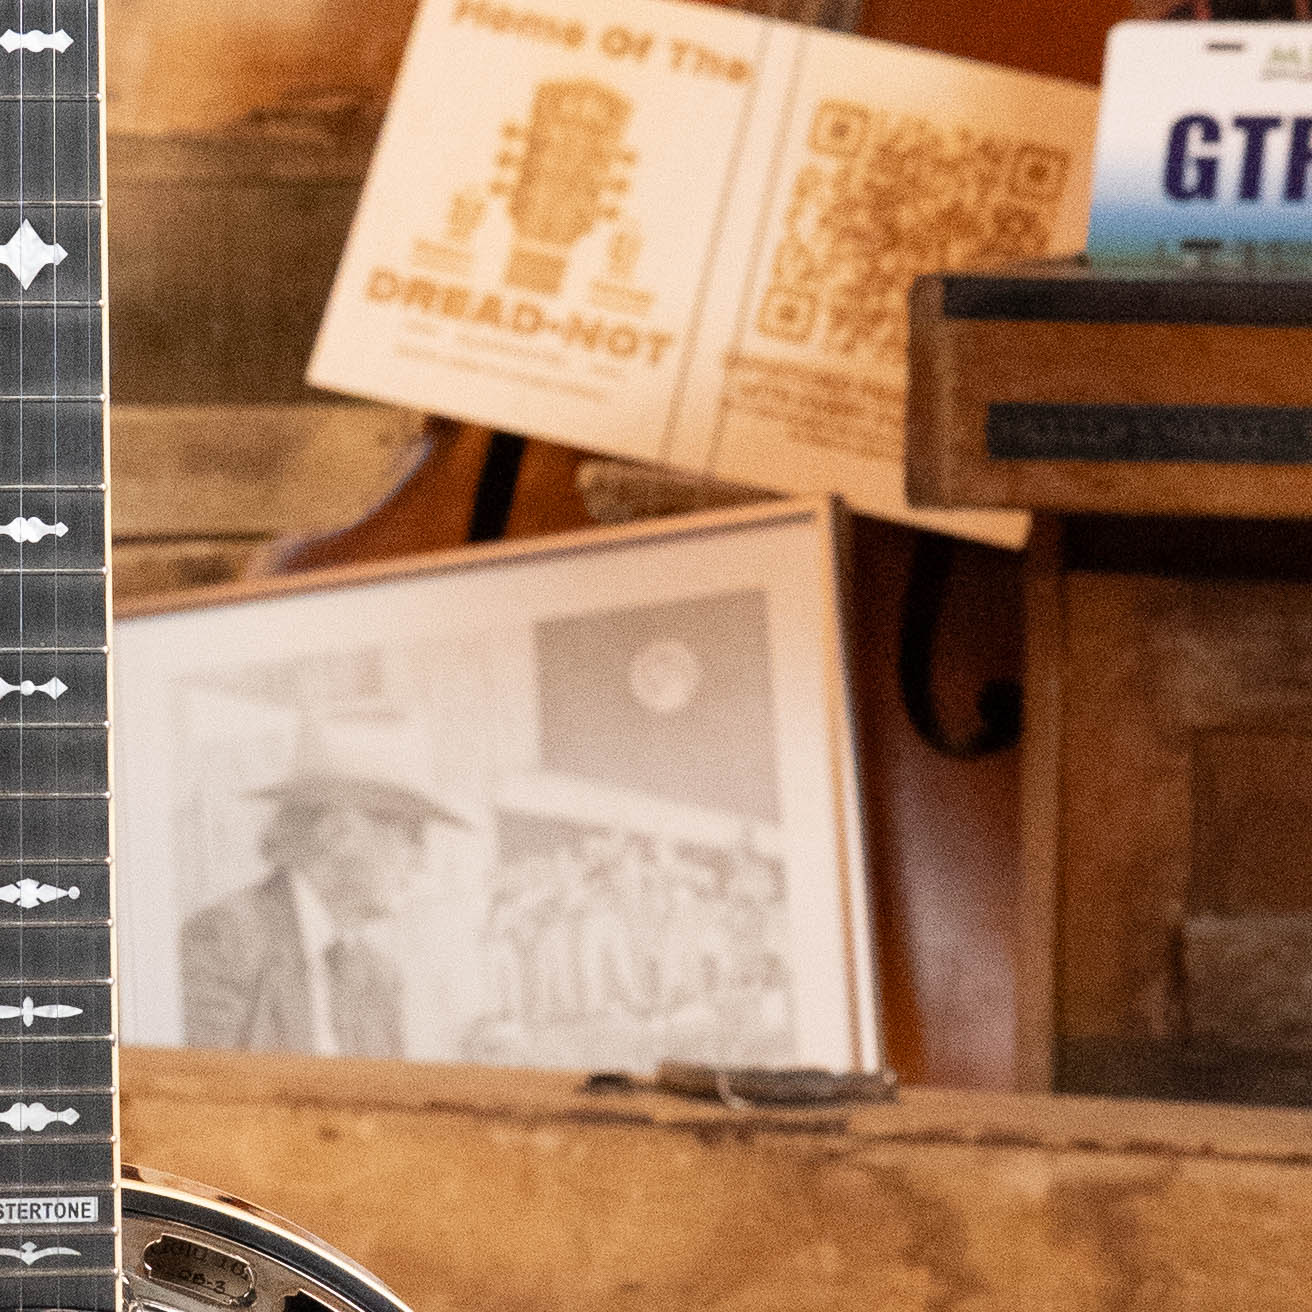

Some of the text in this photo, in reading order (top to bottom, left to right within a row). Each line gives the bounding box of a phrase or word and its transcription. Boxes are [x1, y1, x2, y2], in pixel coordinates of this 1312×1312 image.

[600, 25, 655, 62] Of
[669, 39, 754, 85] The
[365, 265, 677, 369] DREAD-NOT
